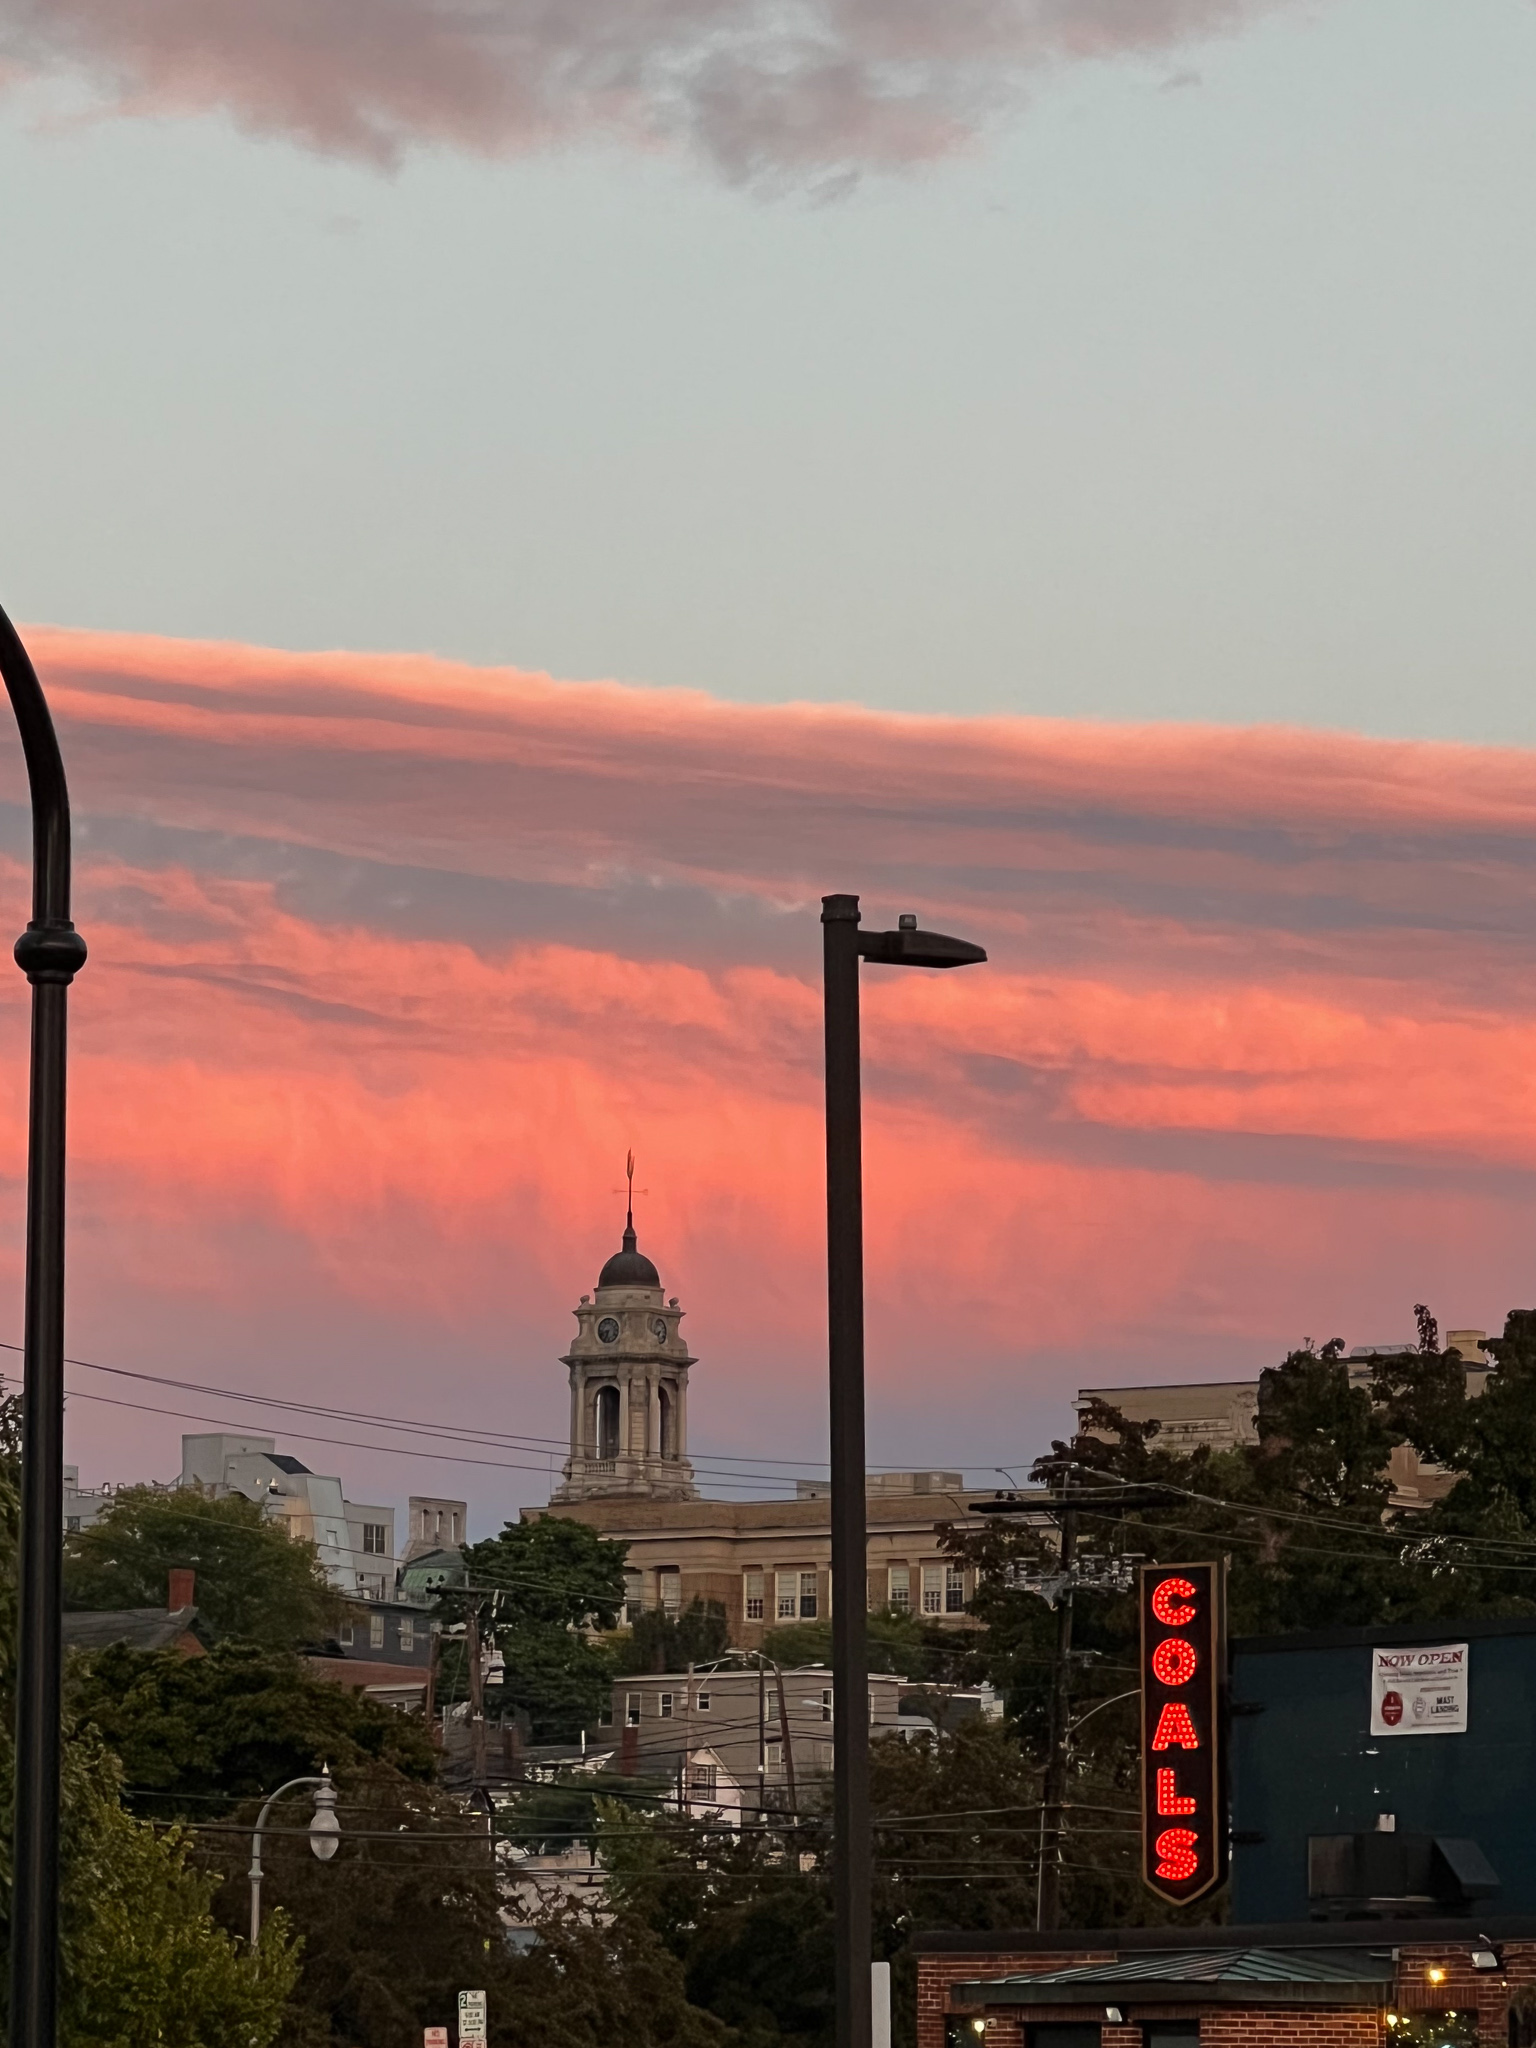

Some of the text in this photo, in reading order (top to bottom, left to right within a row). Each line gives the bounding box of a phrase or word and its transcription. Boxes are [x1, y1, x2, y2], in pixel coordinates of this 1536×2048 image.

[1378, 1650, 1464, 1667] NOW OPEN
[1436, 1696, 1454, 1704] MAST
[1152, 1577, 1199, 1881] COALS
[460, 1994, 467, 2007] 2
